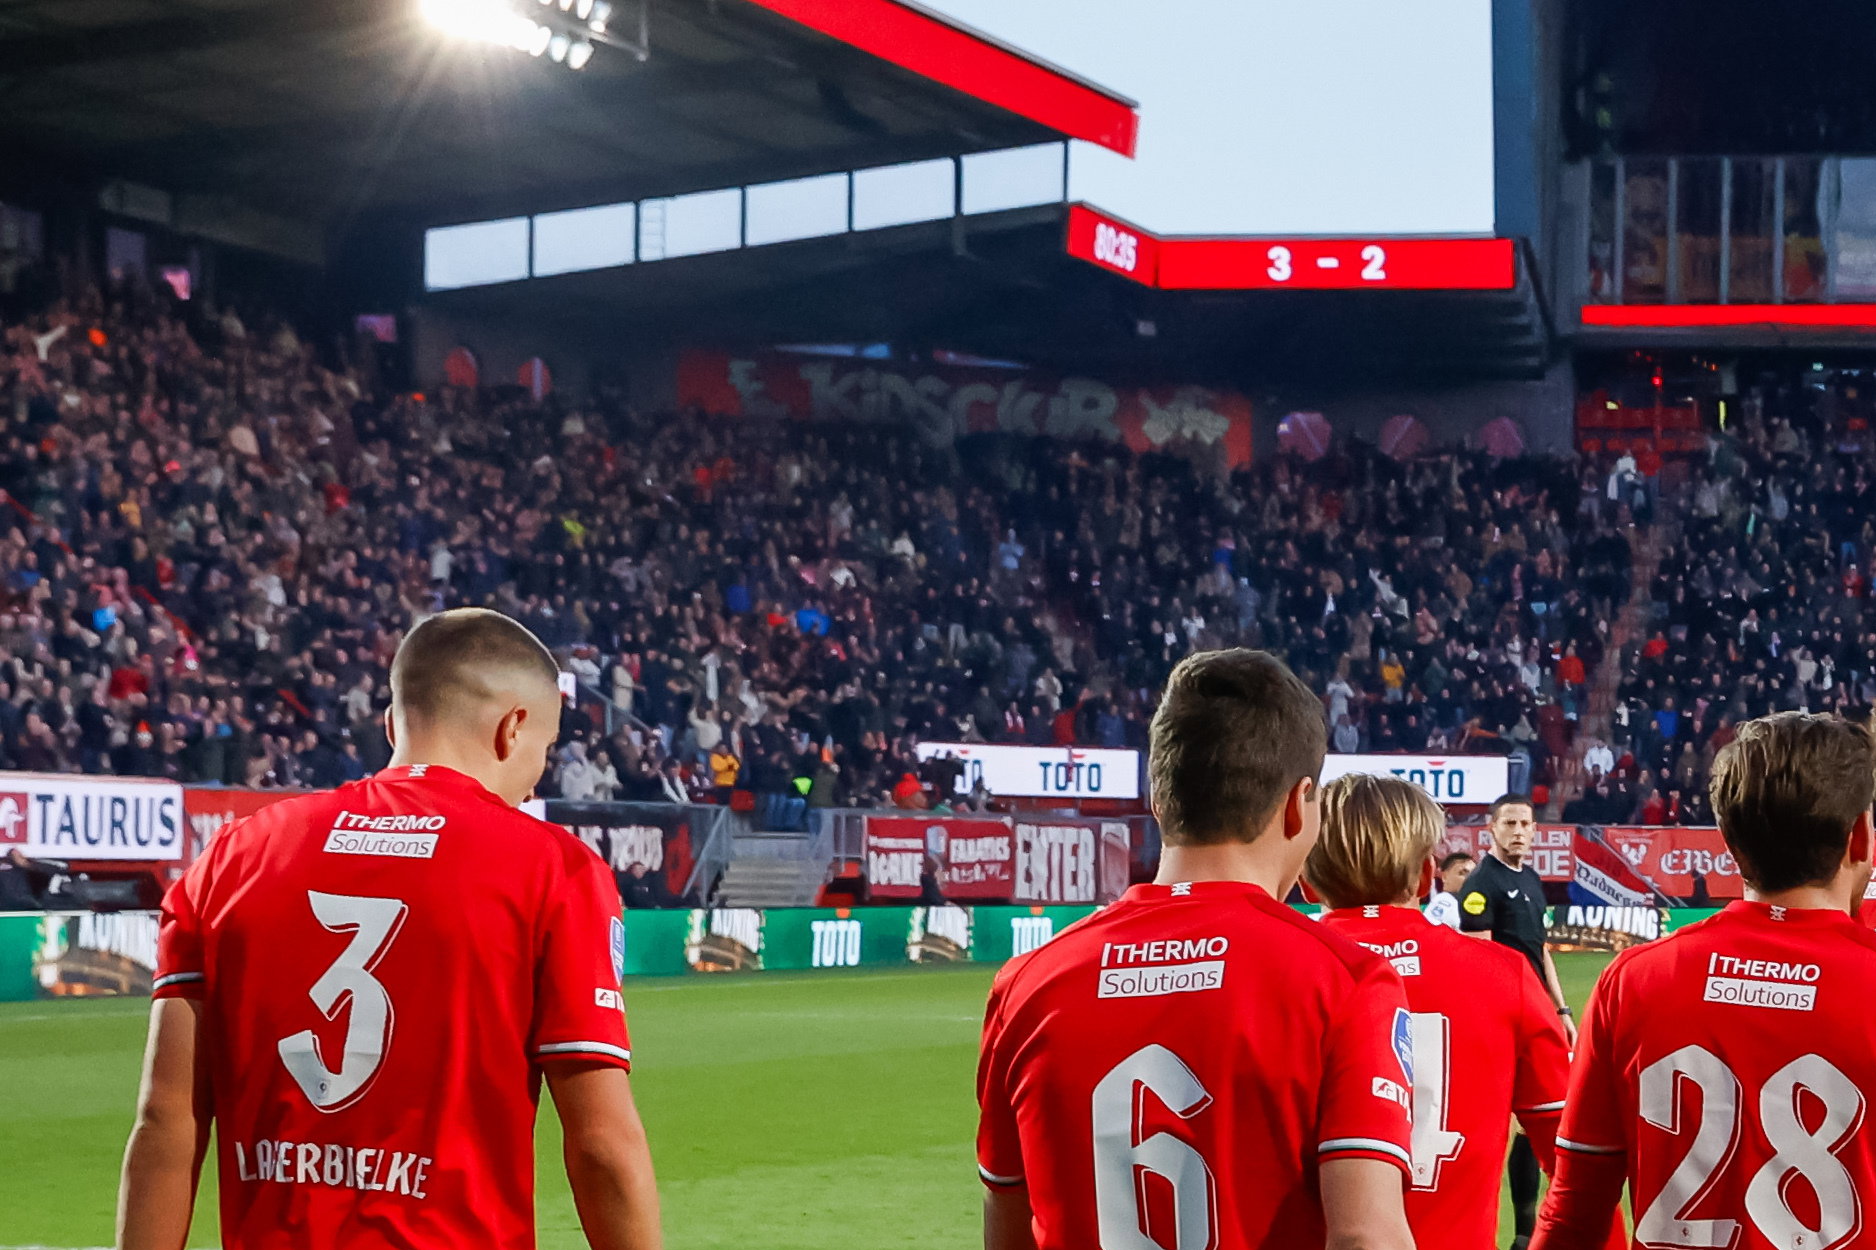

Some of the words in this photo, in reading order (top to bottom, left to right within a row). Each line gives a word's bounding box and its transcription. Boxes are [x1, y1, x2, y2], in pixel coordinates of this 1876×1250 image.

[1267, 246, 1292, 281] 3
[1361, 245, 1386, 280] 2
[1038, 761, 1102, 791] TOTO
[35, 794, 176, 846] TAURUS
[328, 832, 433, 858] Solutions
[811, 920, 862, 968] TOTO
[1102, 966, 1219, 996] Solutions
[1707, 978, 1812, 1009] Solutions
[278, 890, 410, 1113] 3
